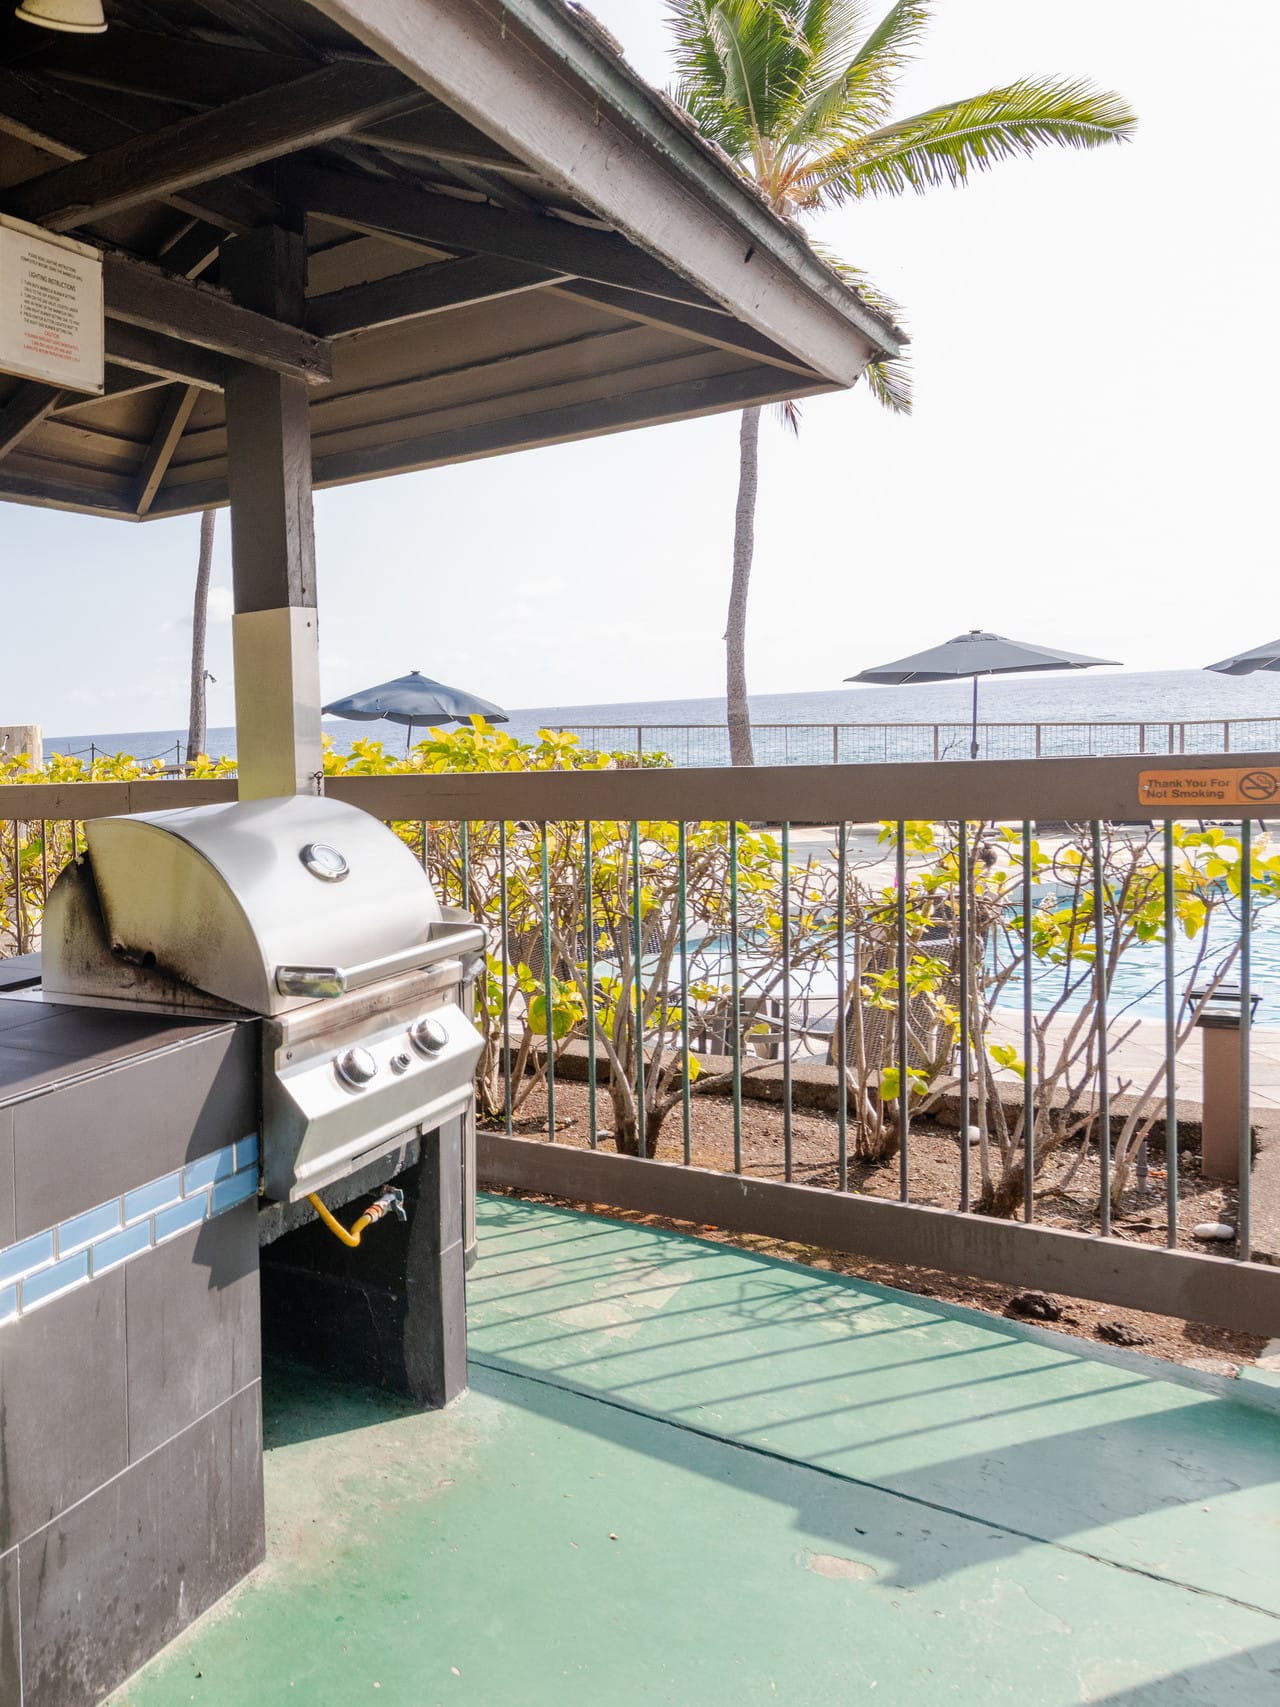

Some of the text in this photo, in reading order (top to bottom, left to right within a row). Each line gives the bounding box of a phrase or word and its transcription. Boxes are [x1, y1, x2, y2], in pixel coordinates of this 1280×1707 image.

[1147, 778, 1231, 788] Thank You For
[1146, 789, 1225, 800] Not Smoking
